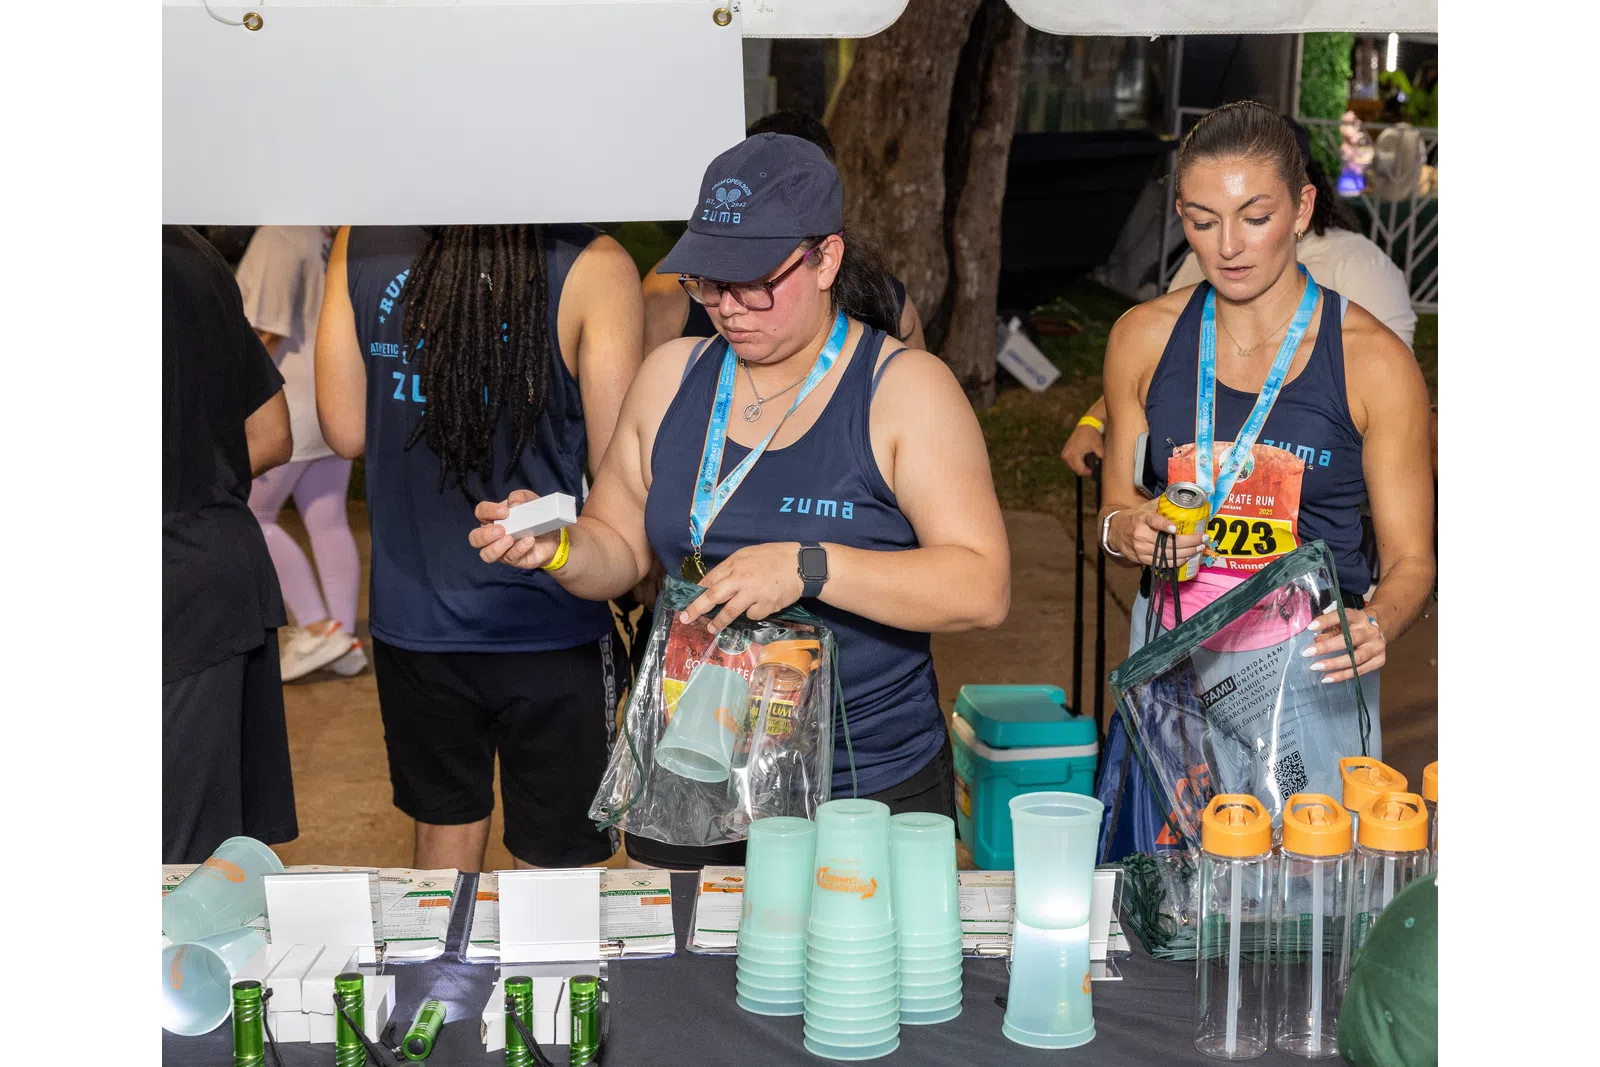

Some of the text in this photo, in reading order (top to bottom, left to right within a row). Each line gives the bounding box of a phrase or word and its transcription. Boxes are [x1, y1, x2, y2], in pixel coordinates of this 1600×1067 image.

[701, 209, 741, 224] zuma
[780, 497, 854, 520] zuma
[1256, 496, 1274, 506] RUN
[1259, 508, 1272, 516] 2025
[1232, 646, 1283, 679] FLORIDA A&M
[1236, 657, 1280, 687] UNIVERSITY
[1237, 670, 1277, 696] MARIJUANA
[1249, 685, 1266, 697] AND
[1203, 680, 1235, 706] FAMU
[1279, 728, 1295, 740] more
